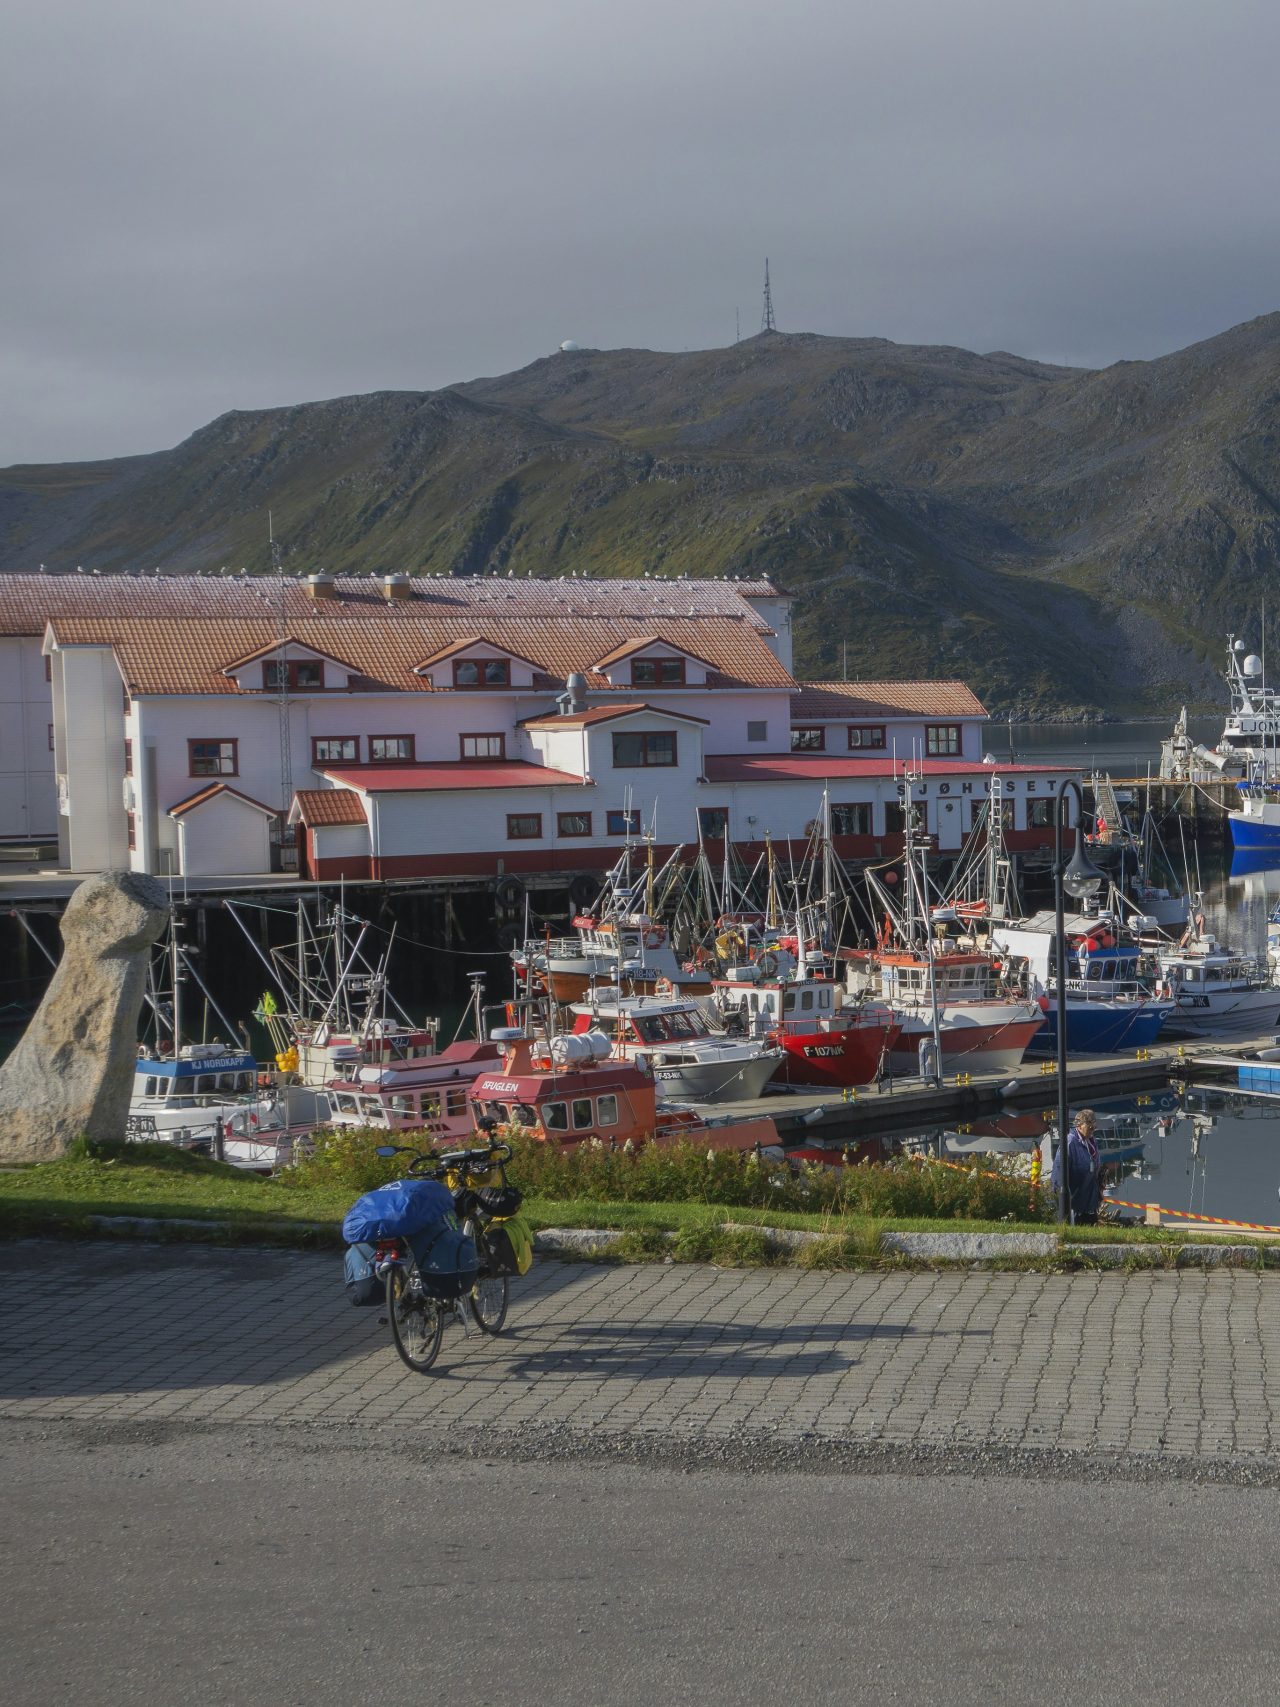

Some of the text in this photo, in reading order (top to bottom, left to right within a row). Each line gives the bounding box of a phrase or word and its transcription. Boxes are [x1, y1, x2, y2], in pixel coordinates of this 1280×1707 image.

[897, 780, 1057, 795] SJØHUSET
[203, 1057, 245, 1069] NORDKAPP
[482, 1080, 519, 1092] ISFUGLEN
